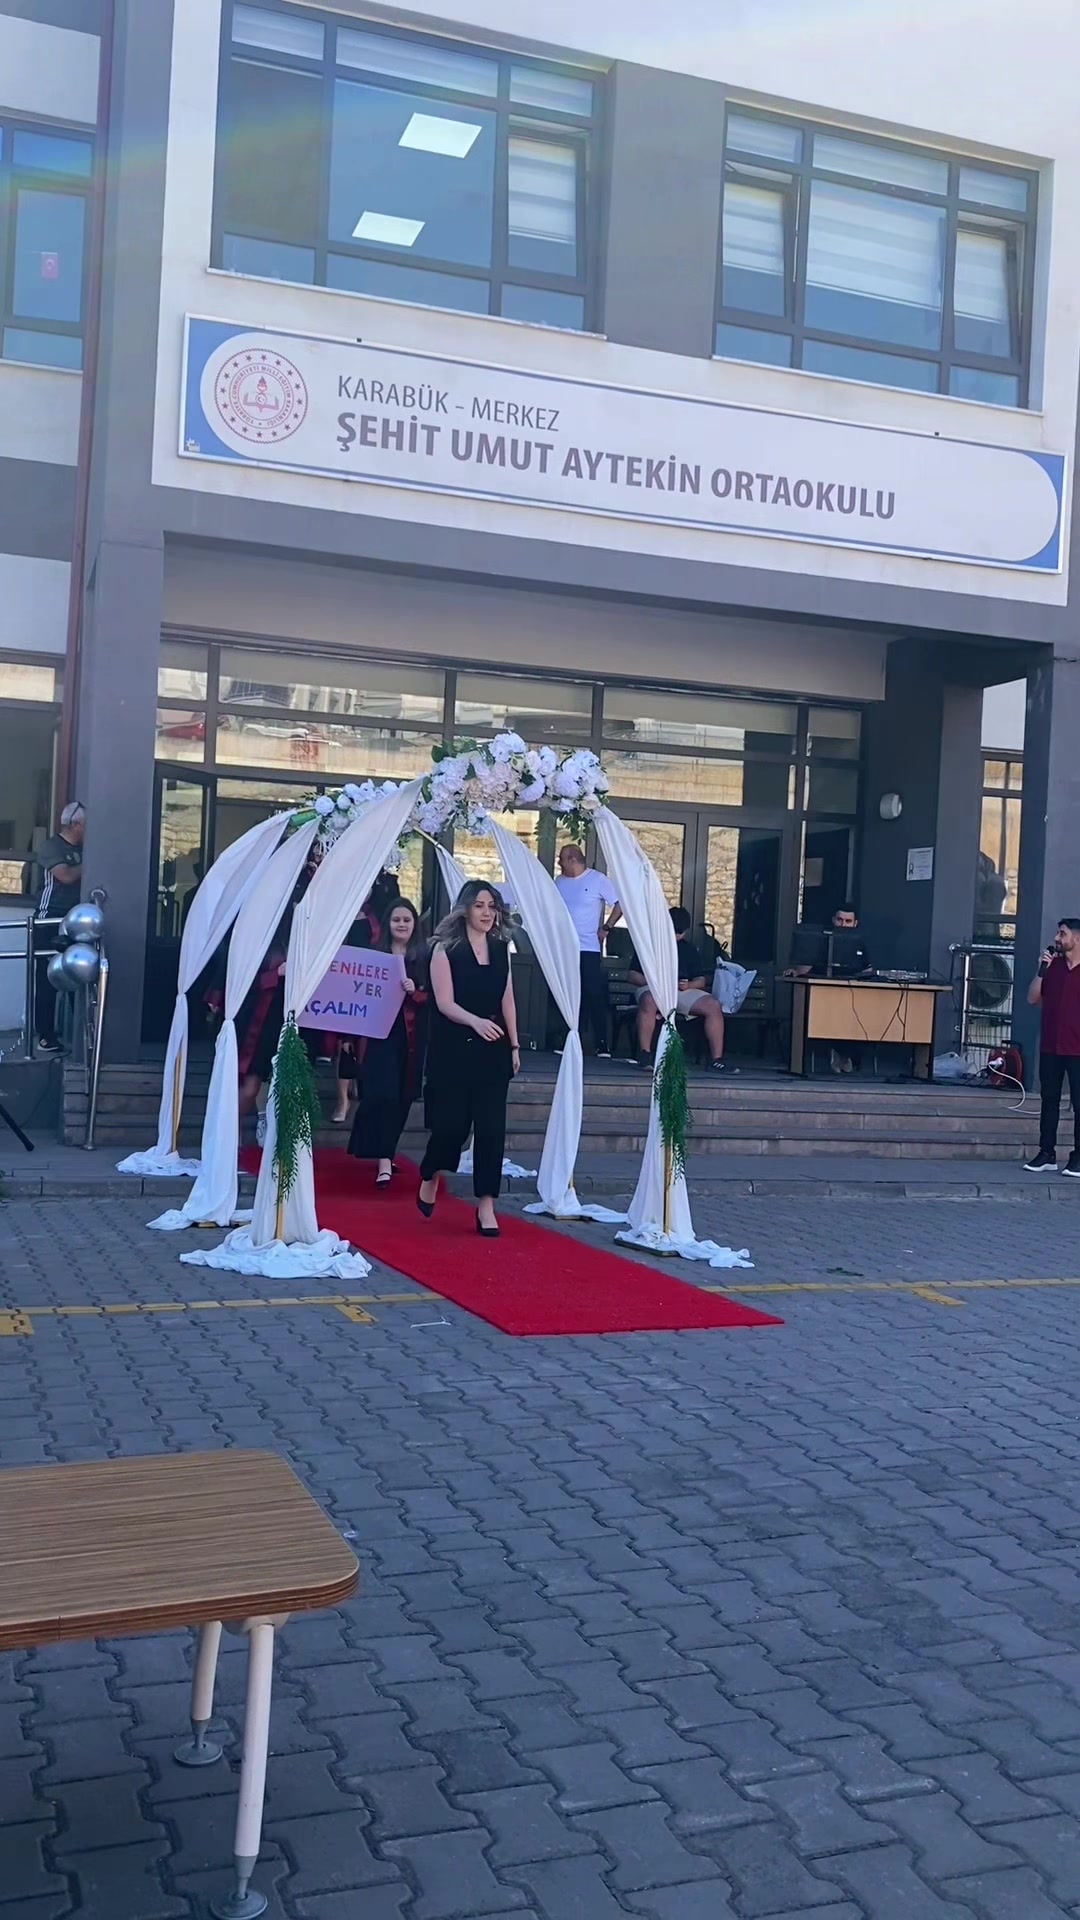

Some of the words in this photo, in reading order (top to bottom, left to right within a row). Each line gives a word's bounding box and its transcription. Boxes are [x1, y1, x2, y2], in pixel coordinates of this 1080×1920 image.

[338, 375, 449, 414] KARABÜK
[471, 397, 560, 432] MERKEZ
[336, 412, 441, 456] ŞEHİT
[451, 429, 554, 474] UMUT
[561, 447, 701, 495] AYTEKİN
[711, 468, 895, 520] ORTAOKULU
[329, 960, 390, 981] ENİLERE
[353, 980, 382, 998] YER
